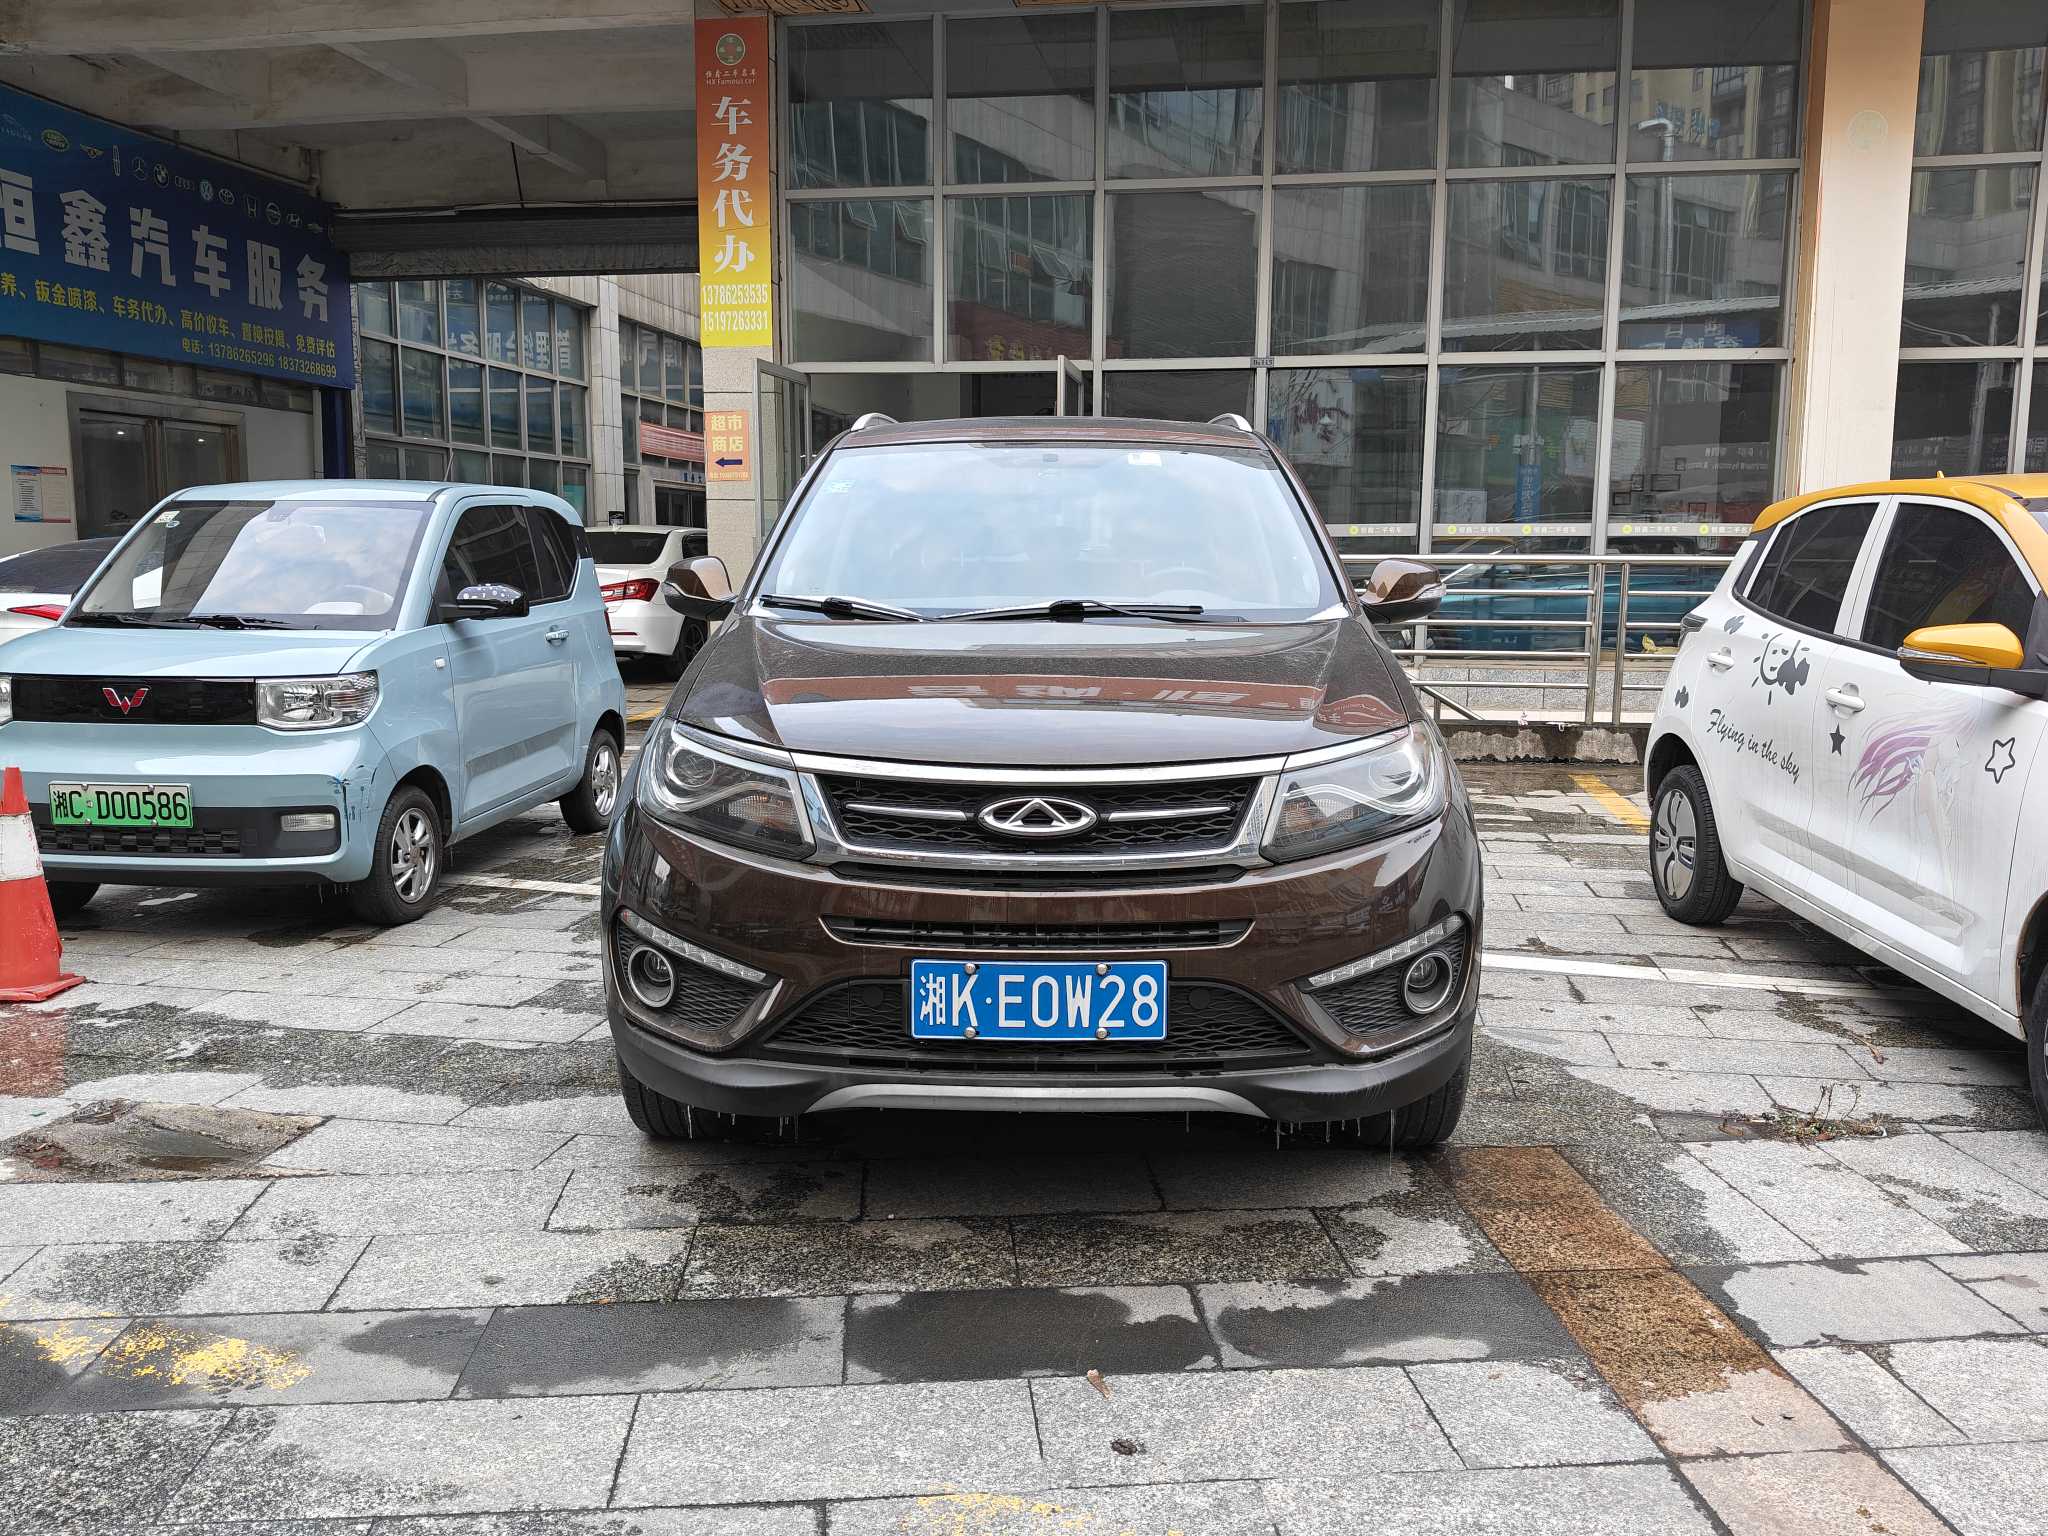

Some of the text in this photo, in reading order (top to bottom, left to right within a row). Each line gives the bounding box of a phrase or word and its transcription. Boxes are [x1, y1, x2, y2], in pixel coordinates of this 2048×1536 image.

[711, 95, 756, 274] 车务代办
[703, 283, 769, 305] 13786253535
[703, 310, 769, 331] 15197263331
[711, 414, 744, 431] 超市
[712, 436, 744, 452] 商店
[1706, 708, 1800, 785] Flying in the sky
